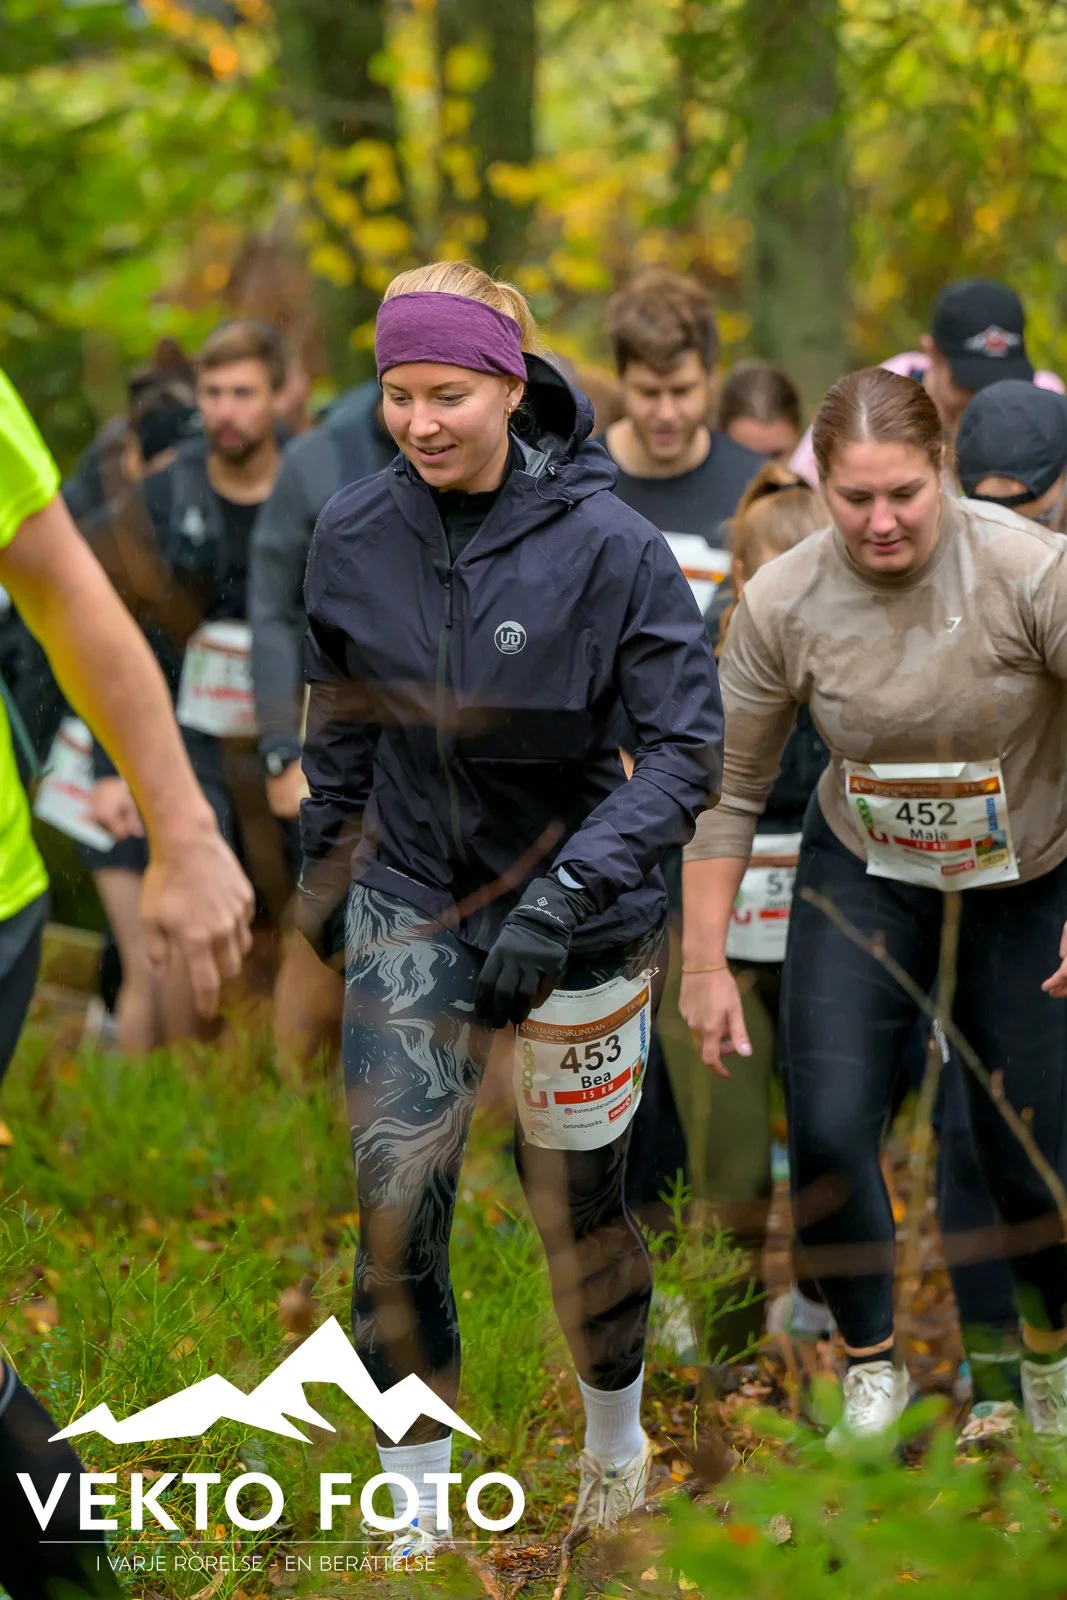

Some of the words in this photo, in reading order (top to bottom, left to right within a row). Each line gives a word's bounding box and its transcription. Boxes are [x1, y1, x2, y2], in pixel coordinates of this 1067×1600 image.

[896, 802, 958, 826] 452
[910, 828, 949, 842] Maja
[560, 1034, 623, 1074] 453
[580, 1071, 612, 1089] Bea
[582, 1090, 595, 1100] 15
[601, 1082, 614, 1095] KM
